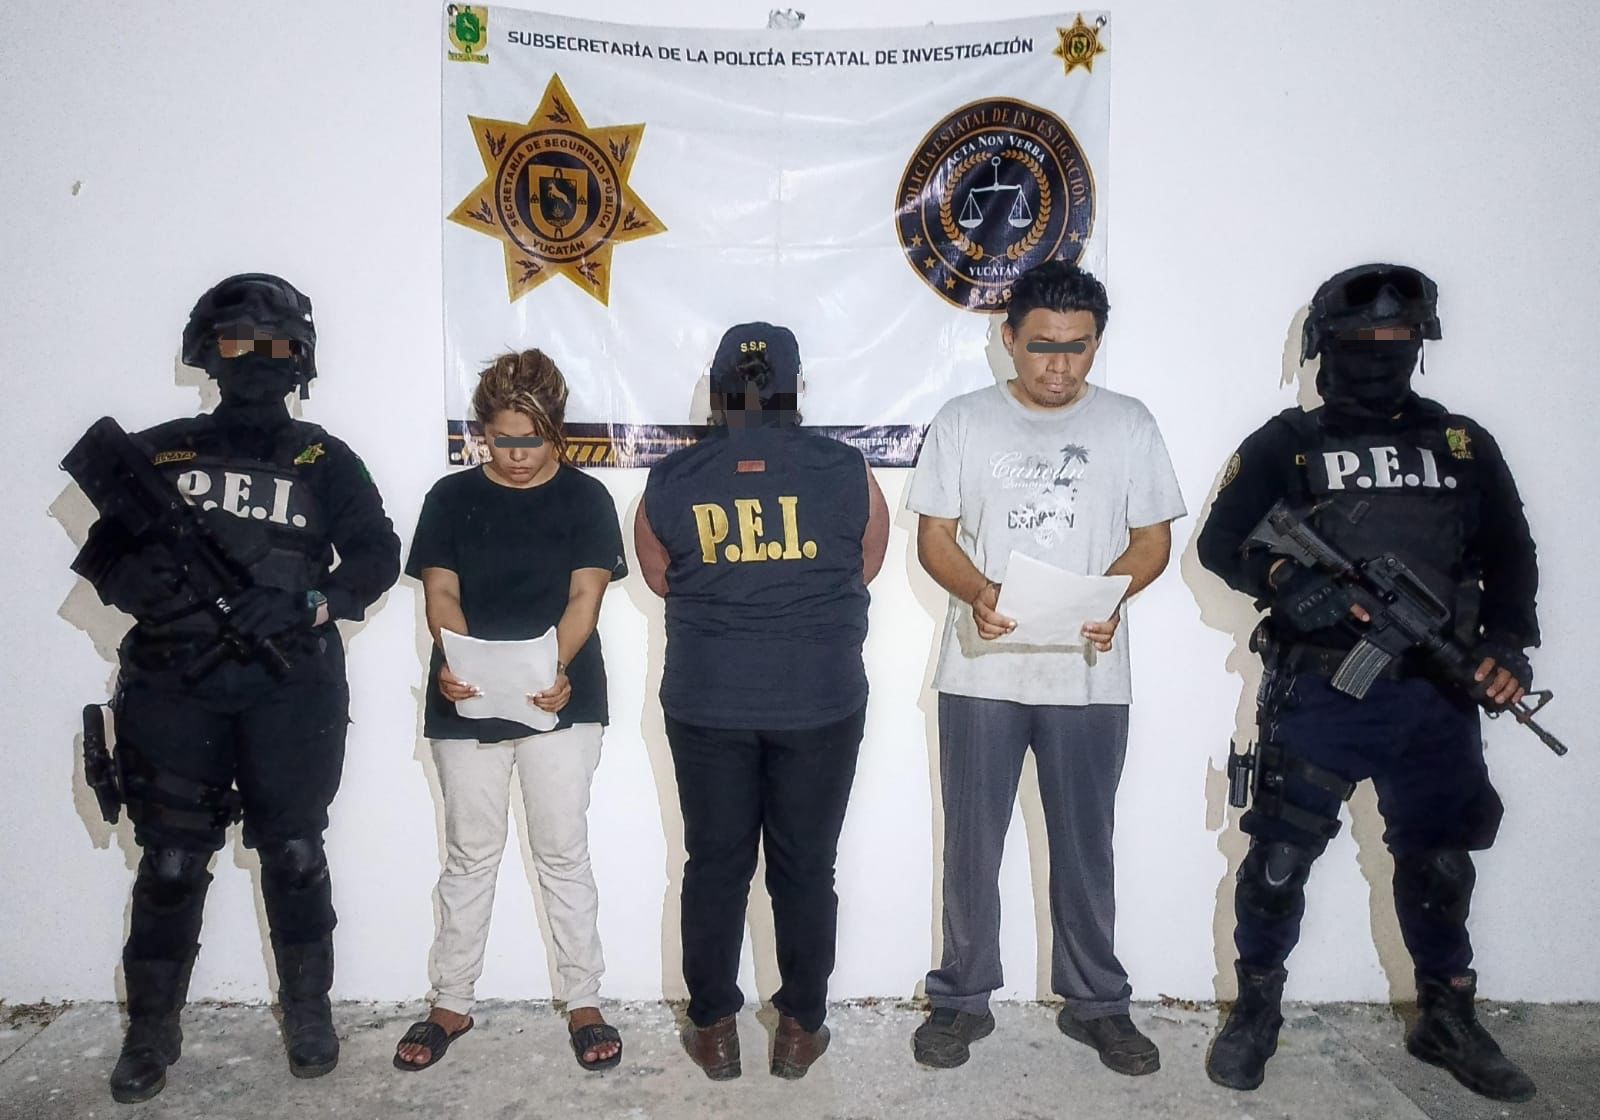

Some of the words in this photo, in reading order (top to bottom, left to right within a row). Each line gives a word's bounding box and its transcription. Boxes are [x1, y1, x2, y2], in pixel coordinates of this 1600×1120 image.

[507, 31, 653, 58] SUBSECRETARÍA
[658, 46, 681, 61] DE
[686, 48, 708, 63] LA
[714, 47, 786, 66] POLICÍA
[791, 51, 869, 66] ESTATAL
[875, 50, 898, 65] DE
[902, 36, 1034, 63] INVESTIGACIÓN
[932, 109, 989, 152] ESTATAL
[992, 107, 1009, 122] DE
[1013, 109, 1089, 207] INVESTIGACIÓN
[948, 143, 976, 168] ACTA
[503, 152, 526, 228] SECRETARÍA
[526, 140, 541, 153] DE
[544, 138, 606, 175] SEGURIDAD
[598, 177, 615, 229] PÚBLICA
[532, 238, 586, 256] YUCATÁN
[969, 263, 1020, 277] YUCATÁN
[1322, 446, 1457, 490] P.E.I.
[177, 469, 307, 528] P.E.I.
[692, 495, 818, 564] P.E.I.
